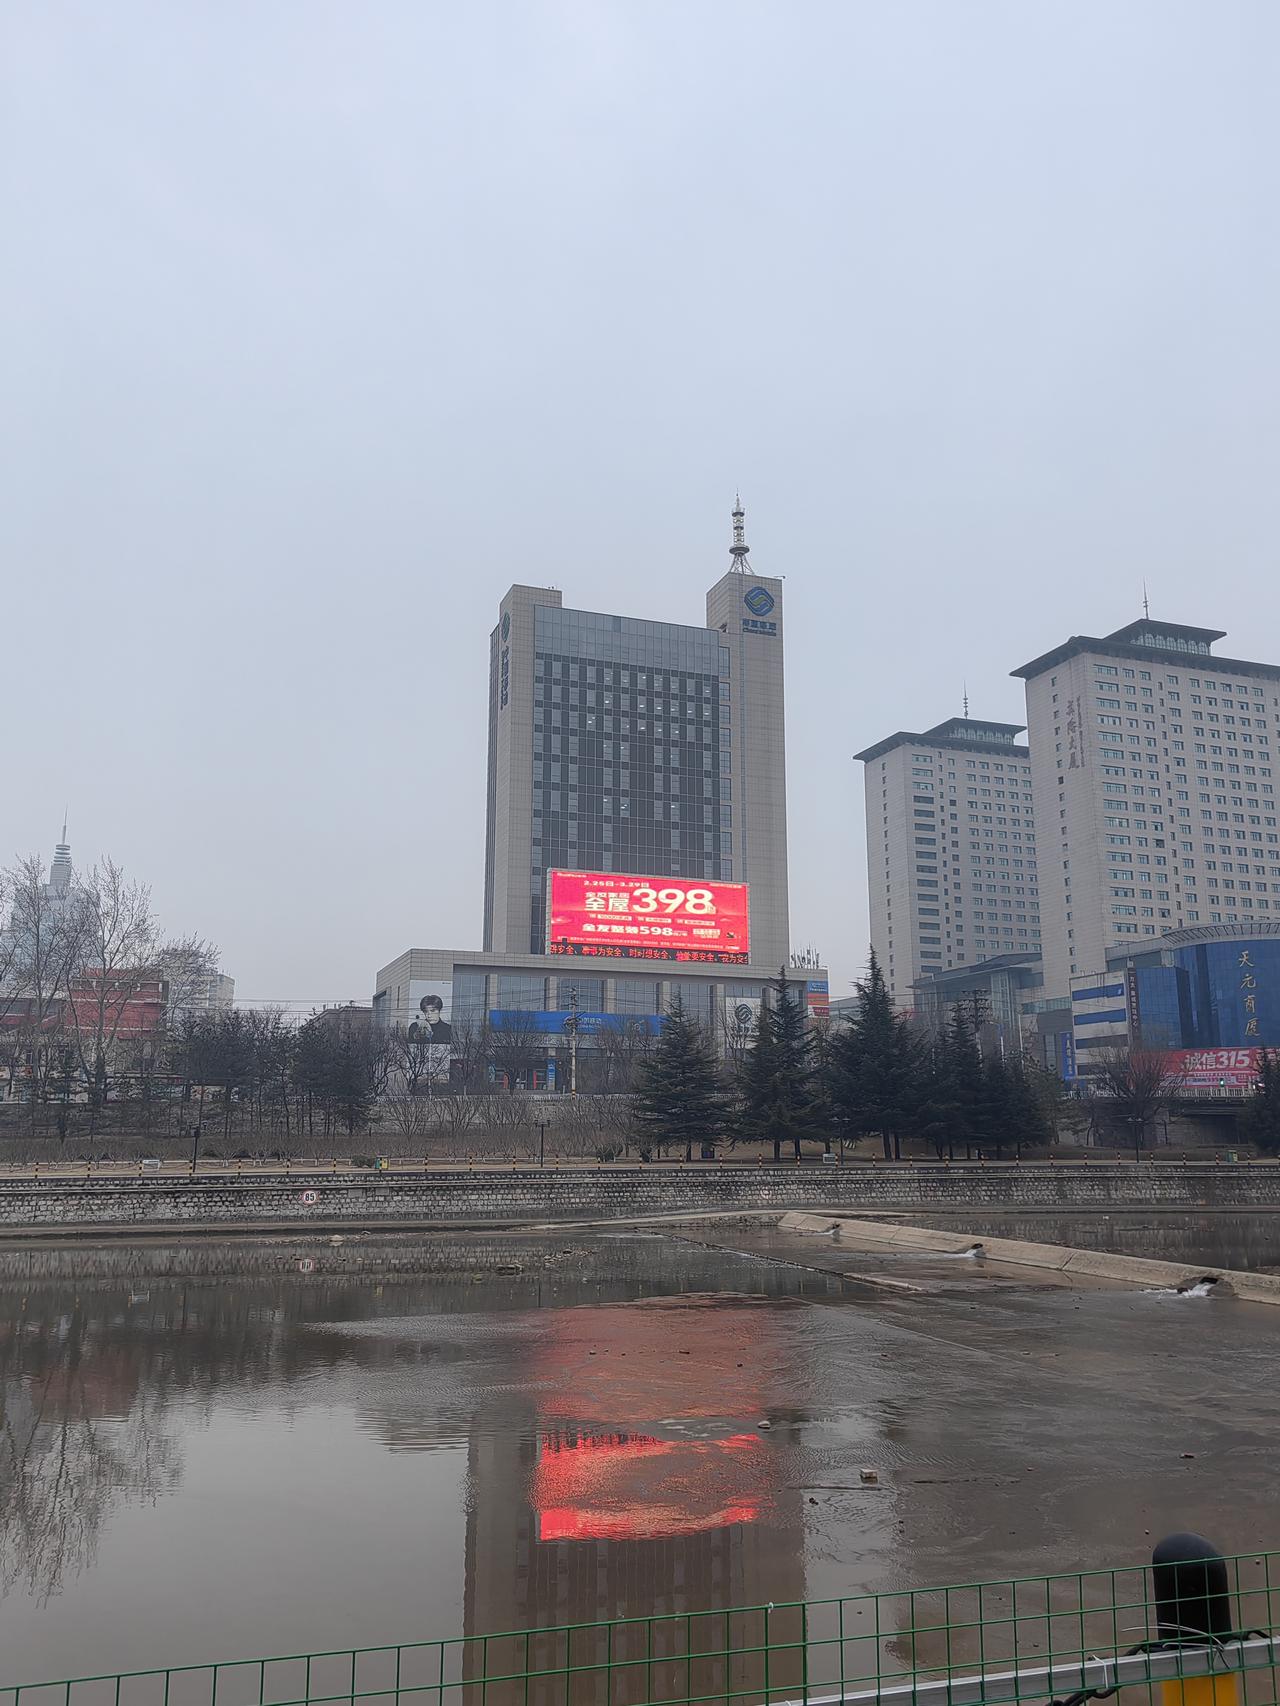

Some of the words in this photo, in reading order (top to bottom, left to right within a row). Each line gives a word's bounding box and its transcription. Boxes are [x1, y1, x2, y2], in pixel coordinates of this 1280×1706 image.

[584, 897, 630, 912] 全屋
[632, 888, 714, 915] 398
[1239, 950, 1260, 1036] 天元商厦
[1184, 1050, 1250, 1071] 诚信315
[305, 1192, 315, 1201] 85
